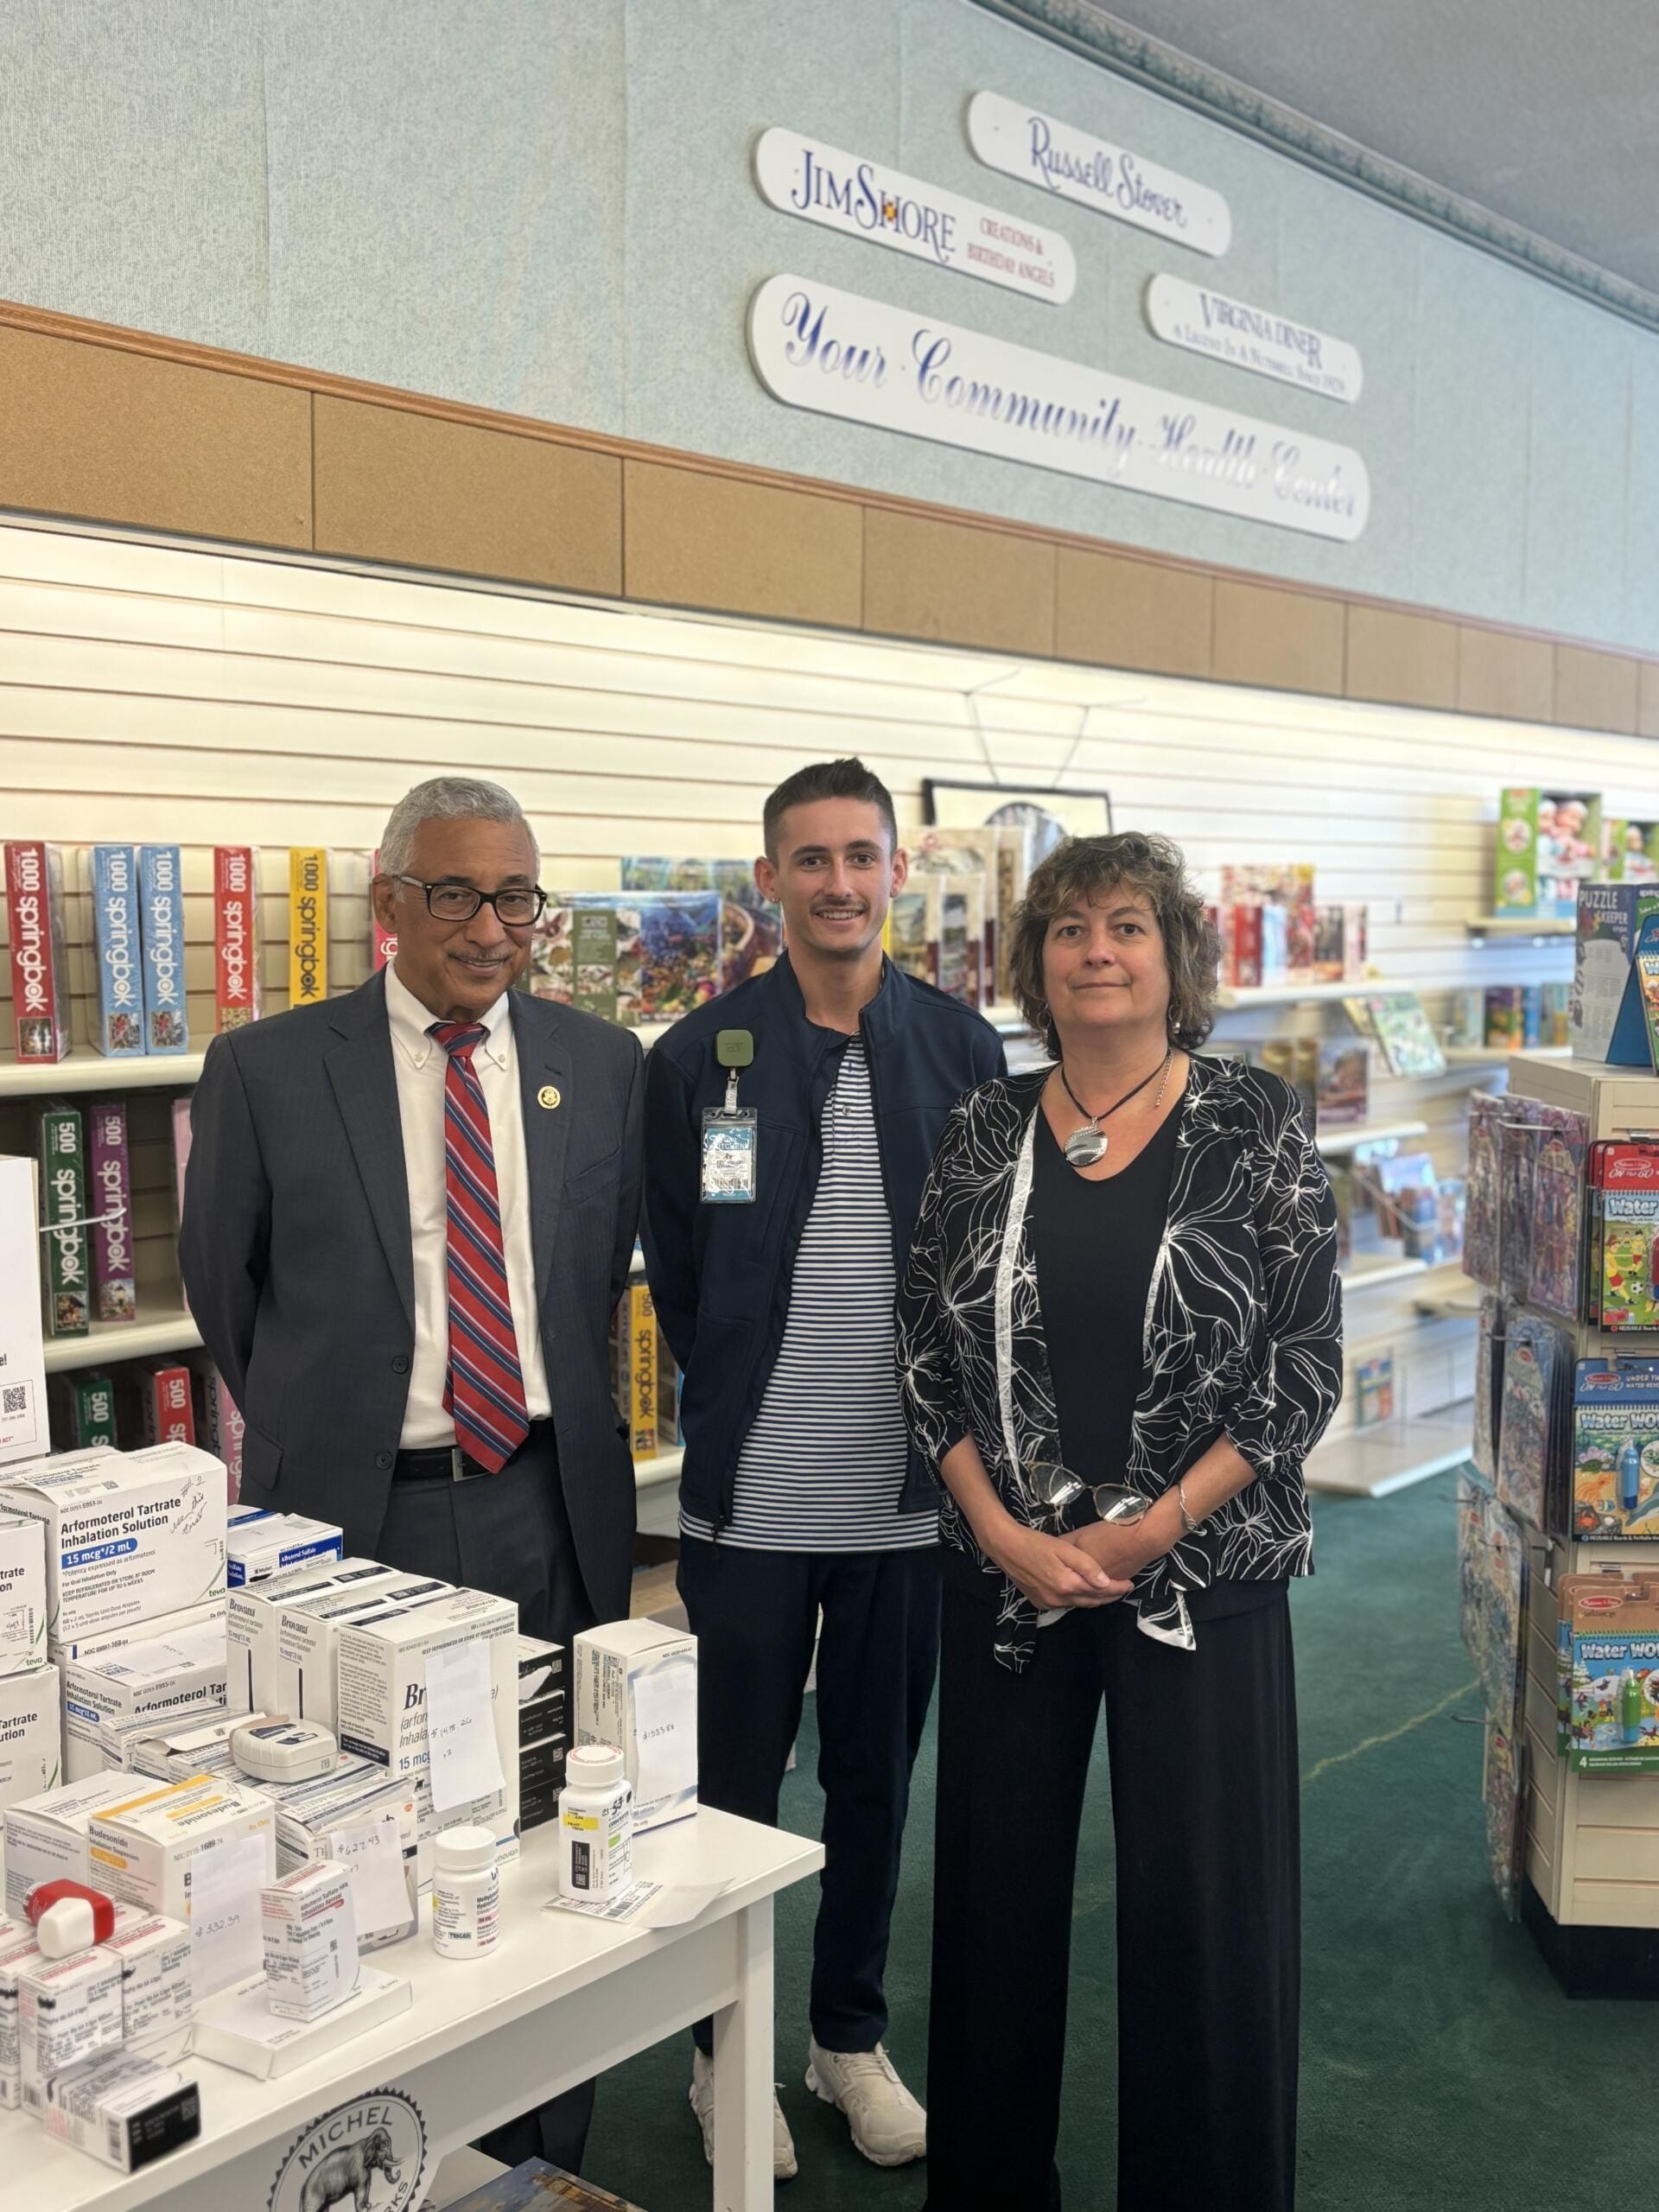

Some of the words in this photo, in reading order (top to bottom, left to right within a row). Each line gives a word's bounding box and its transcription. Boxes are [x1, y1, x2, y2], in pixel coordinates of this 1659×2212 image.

[1027, 116, 1114, 197] Russell
[1116, 153, 1187, 229] Stover
[780, 292, 886, 389] Your
[912, 327, 1136, 478] Community
[20, 849, 41, 892] 1000
[110, 852, 128, 893] 1000
[156, 851, 173, 892] 1000
[229, 855, 246, 893] 1000
[304, 854, 319, 892] 1000
[1579, 890, 1618, 909] PUZZLE
[15, 896, 48, 1013] springbok
[104, 896, 136, 1008] springbok
[149, 896, 178, 1007] springbok
[221, 900, 247, 1001] springbok
[295, 896, 321, 998] springbok
[59, 1122, 76, 1154] 500
[105, 1116, 122, 1146] 500
[1609, 1198, 1658, 1217] Water
[50, 1168, 85, 1286] springbok
[634, 1329, 655, 1419] springbok
[92, 1391, 109, 1423] 500
[169, 1378, 185, 1408] 500
[1580, 1413, 1629, 1431] Water
[60, 1508, 134, 1535] Arformoterol
[137, 1497, 181, 1516] Tartrate
[60, 1527, 119, 1548] Inhalation
[123, 1515, 168, 1534] Solution
[67, 1554, 79, 1566] 15
[117, 1542, 132, 1553] mL
[87, 1561, 116, 1573] expressed
[141, 1568, 156, 1578] ROOM
[208, 1587, 226, 1598] teva
[25, 1656, 42, 1666] teva
[1580, 1643, 1628, 1661] Water
[67, 1681, 99, 1700] Arformoterol
[99, 1694, 123, 1708] Tartrate
[67, 1690, 92, 1705] Inhalation
[91, 1699, 116, 1715] Solution
[135, 1686, 207, 1713] Arformoterol
[398, 1756, 410, 1770] 15
[1579, 1756, 1587, 1768] 4
[89, 1825, 129, 1848] Budesonide
[321, 1887, 339, 1901] Sulfate
[298, 2105, 394, 2171] MICHEL
